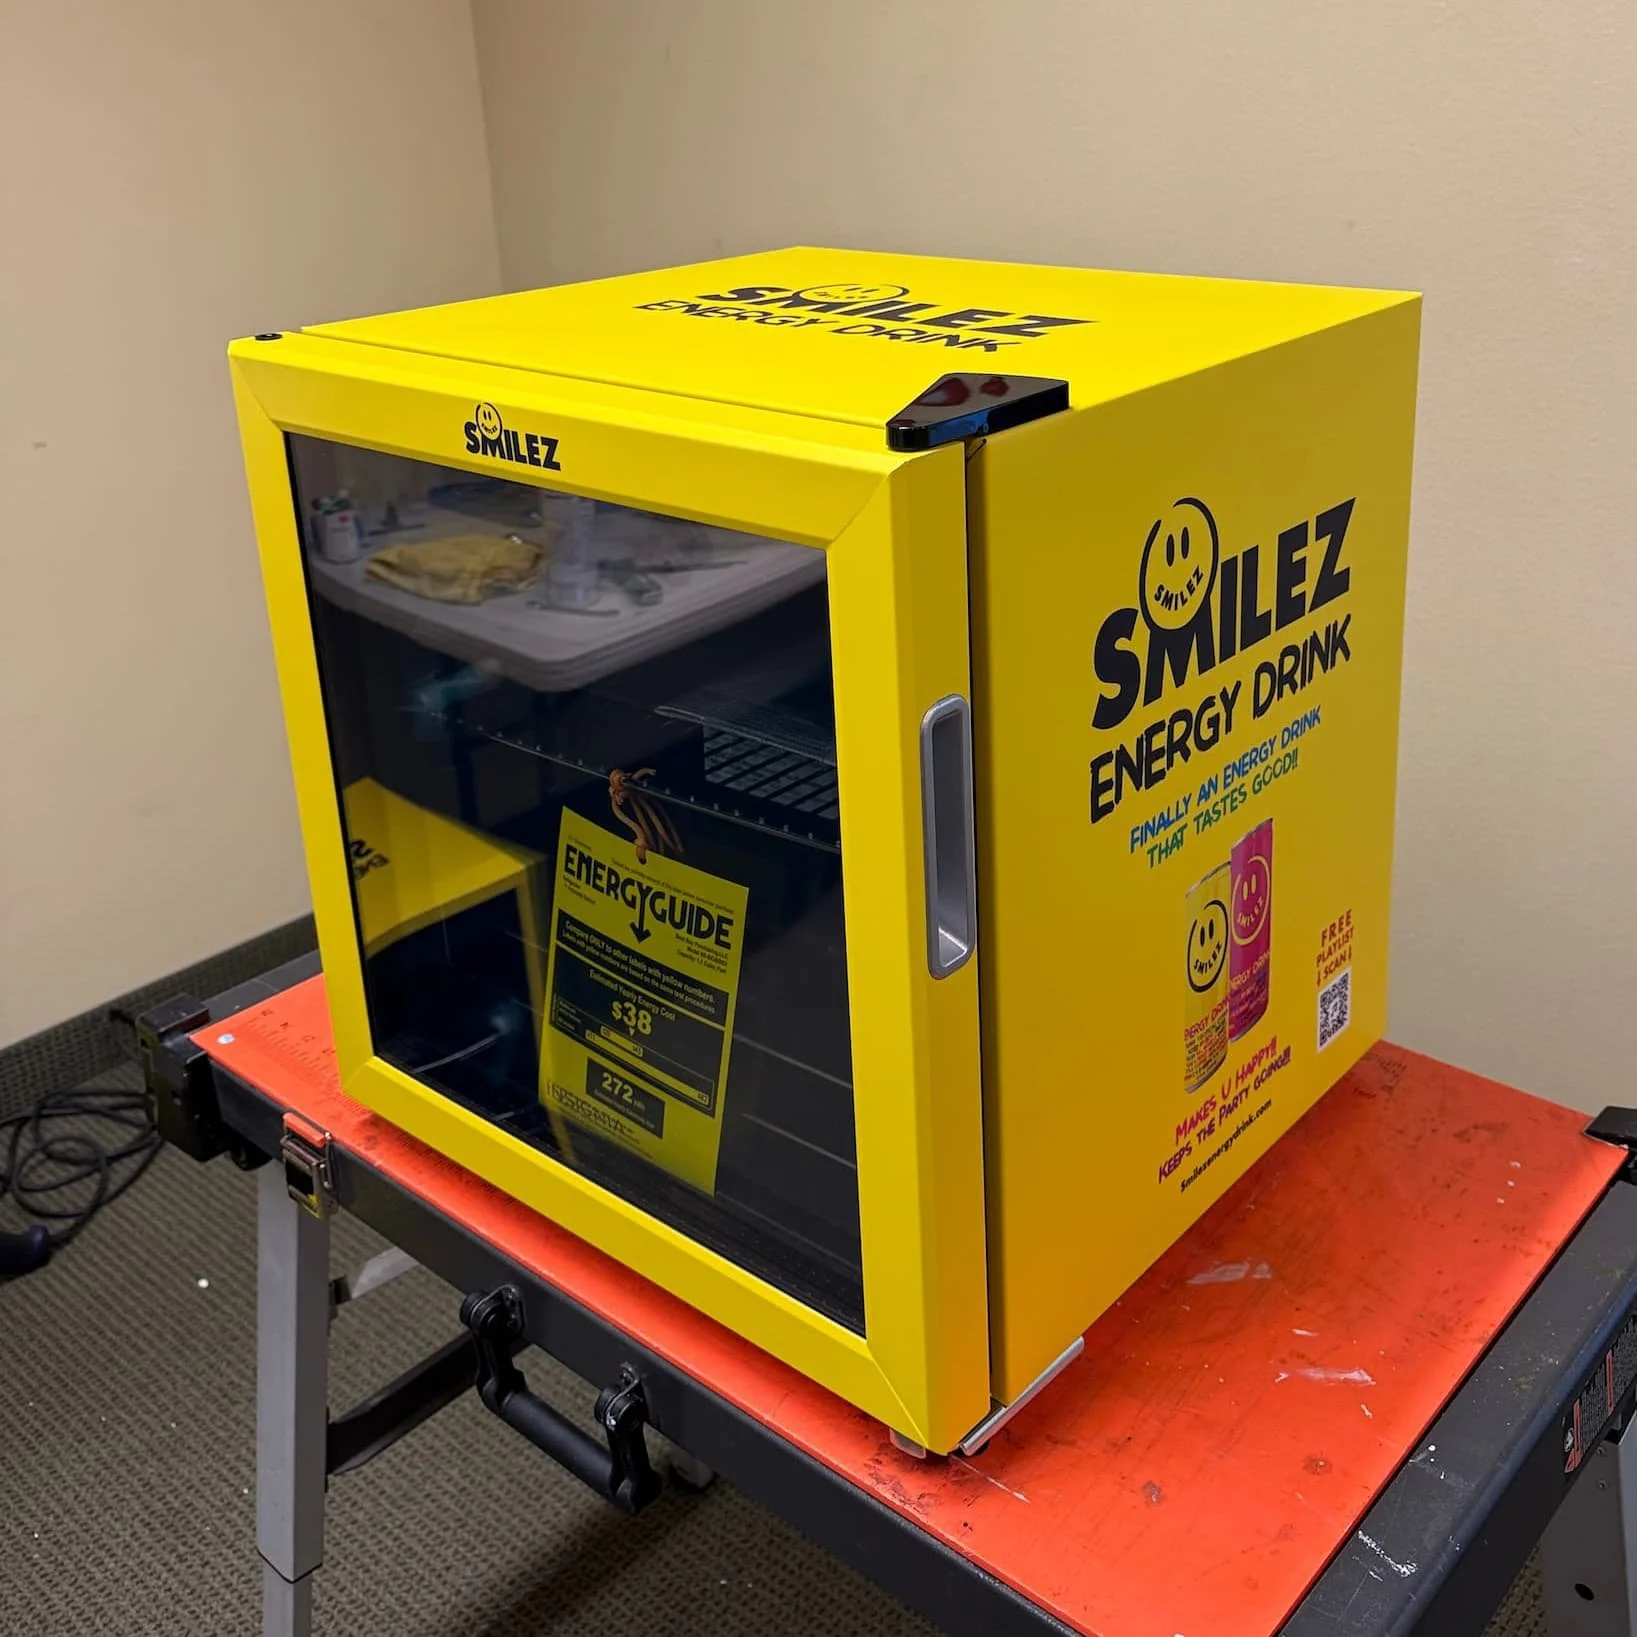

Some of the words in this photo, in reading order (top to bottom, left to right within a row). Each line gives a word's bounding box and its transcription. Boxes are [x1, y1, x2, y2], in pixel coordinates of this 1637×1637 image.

[633, 299, 838, 328] ENERGY
[829, 323, 1022, 352] DRINK
[696, 286, 1099, 338] SMILEZ
[463, 420, 562, 472] SMILEZ
[1092, 497, 1357, 730] SMILEZ
[1153, 565, 1204, 612] SMILEZ
[1090, 680, 1242, 825] ENERGY
[1252, 613, 1352, 721] DRINK
[1130, 792, 1192, 854] FINALLY
[1196, 773, 1219, 807] AN
[1223, 734, 1278, 791] ENERGY
[1281, 703, 1322, 750] DRINK
[1146, 822, 1189, 869] THAT
[1193, 782, 1248, 836] TASTES
[1252, 746, 1298, 796] GOOD!!
[564, 843, 734, 950] ENERGYGUIDE
[1316, 925, 1355, 969] PLAYLIST
[1320, 908, 1352, 947] FREE
[1323, 949, 1347, 981] SCAN
[611, 1000, 652, 1036] $38
[602, 1072, 634, 1105] 272
[1175, 1095, 1218, 1146] MAKES
[1221, 1076, 1232, 1101] U
[1158, 1141, 1193, 1185] KEEPS
[1196, 1116, 1216, 1145] THE
[1218, 1084, 1250, 1127] PARTY
